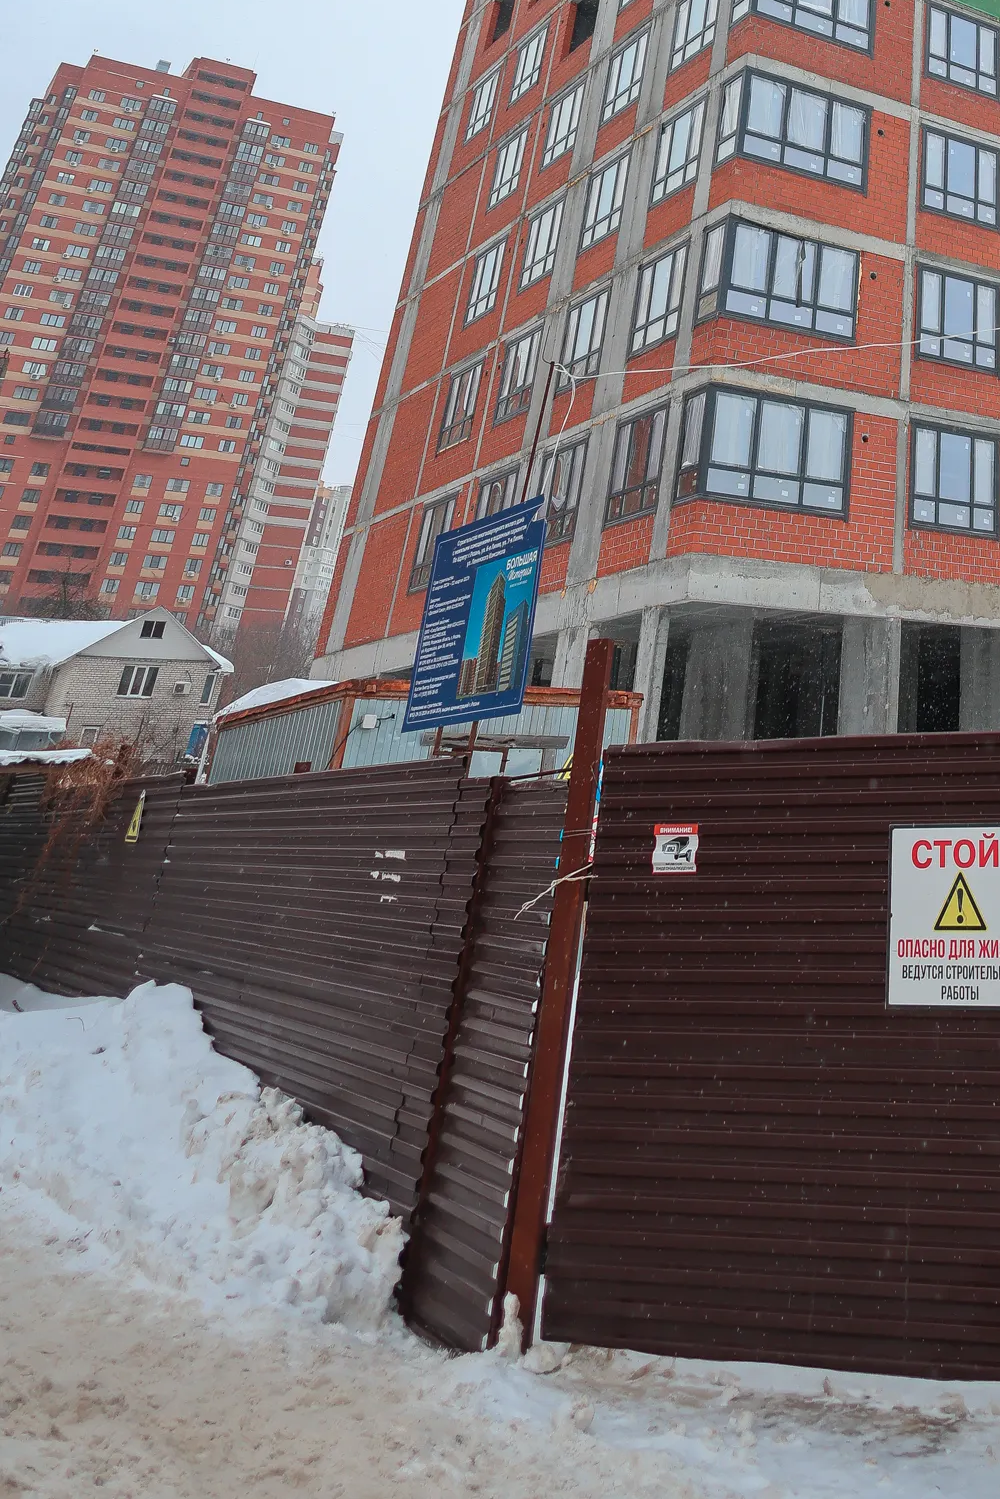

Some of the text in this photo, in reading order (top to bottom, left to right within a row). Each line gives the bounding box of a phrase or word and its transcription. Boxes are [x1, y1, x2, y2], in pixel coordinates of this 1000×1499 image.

[506, 550, 538, 570] БОЛЬШАЯ
[897, 939, 945, 959] ОПАСНО
[948, 939, 975, 960] ДЛЯ
[902, 965, 944, 981] ВЕДУТСЯ
[941, 986, 979, 1000] РАБОТЫ
